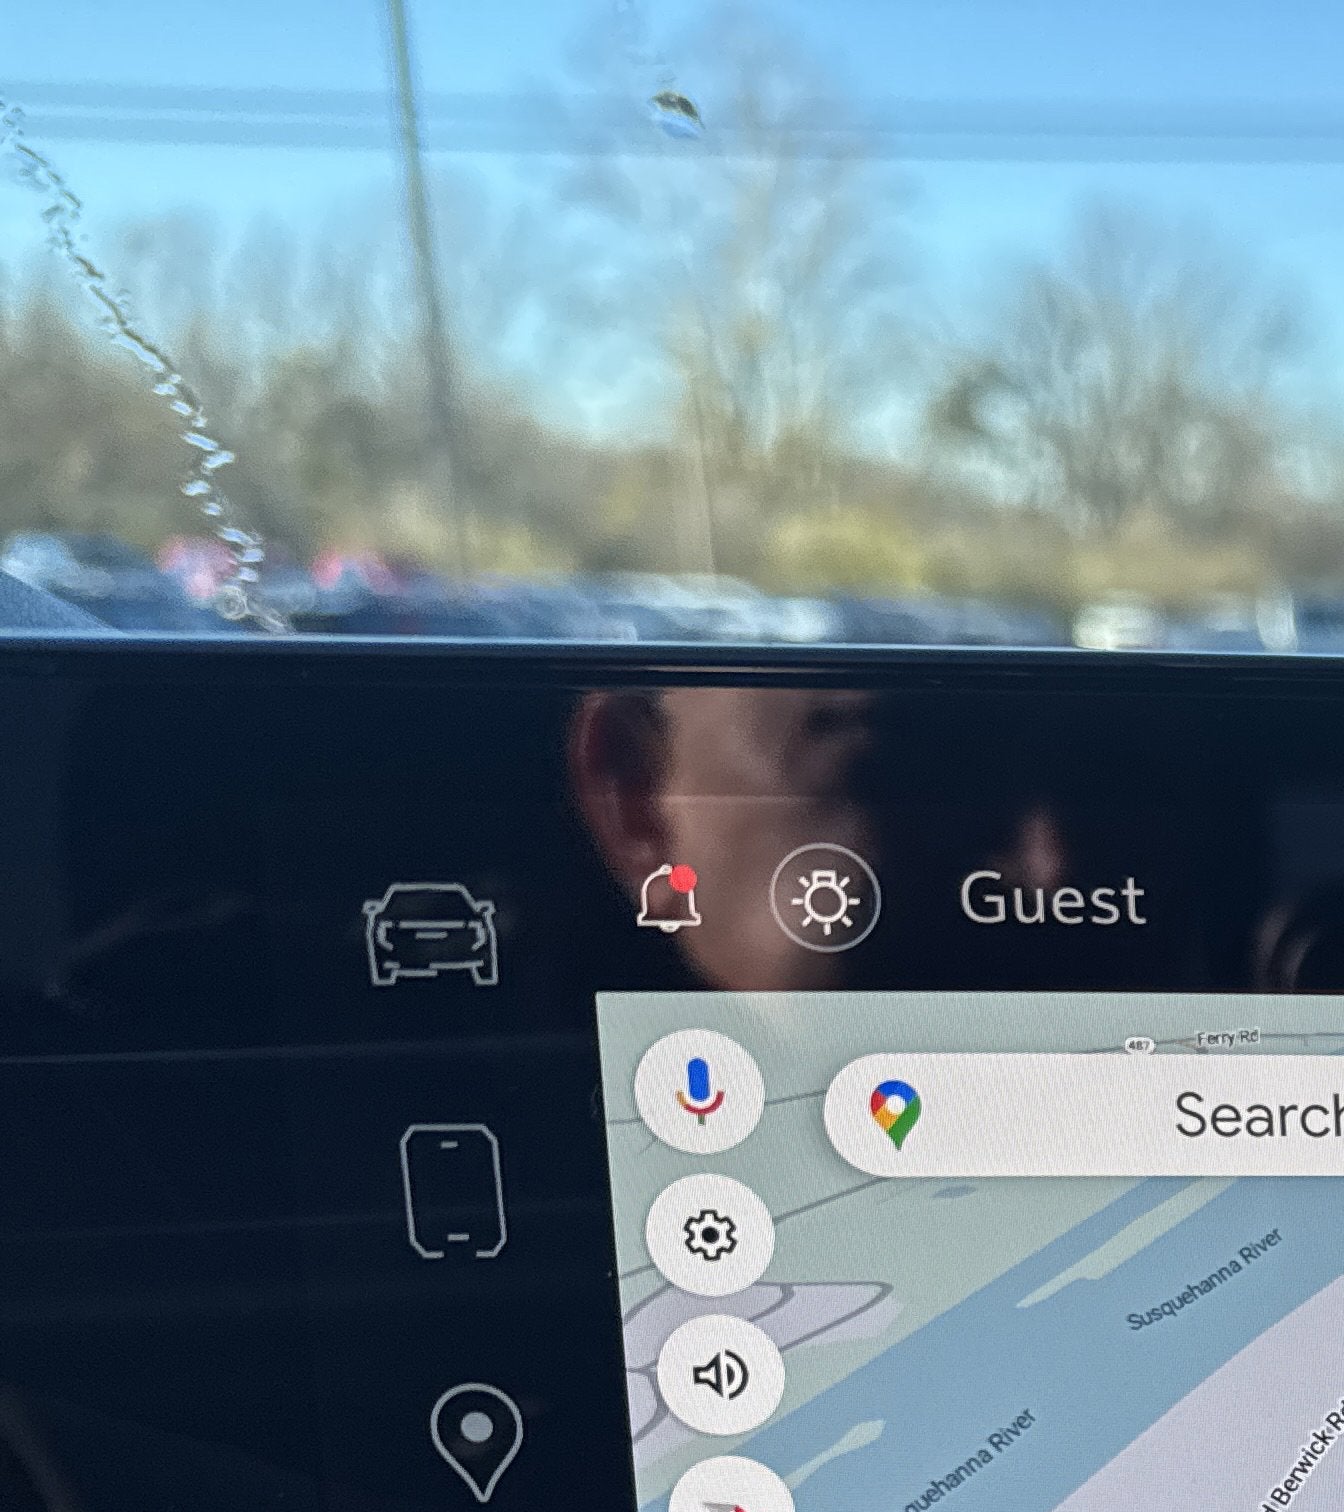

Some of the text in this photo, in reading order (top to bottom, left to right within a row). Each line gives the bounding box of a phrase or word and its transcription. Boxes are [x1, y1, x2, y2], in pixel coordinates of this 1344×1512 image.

[961, 870, 1147, 925] Guest
[1197, 1030, 1235, 1047] Ferry
[1126, 1227, 1284, 1332] Susquehanna River
[988, 1408, 1037, 1454] River
[1271, 1429, 1330, 1506] Berwick
